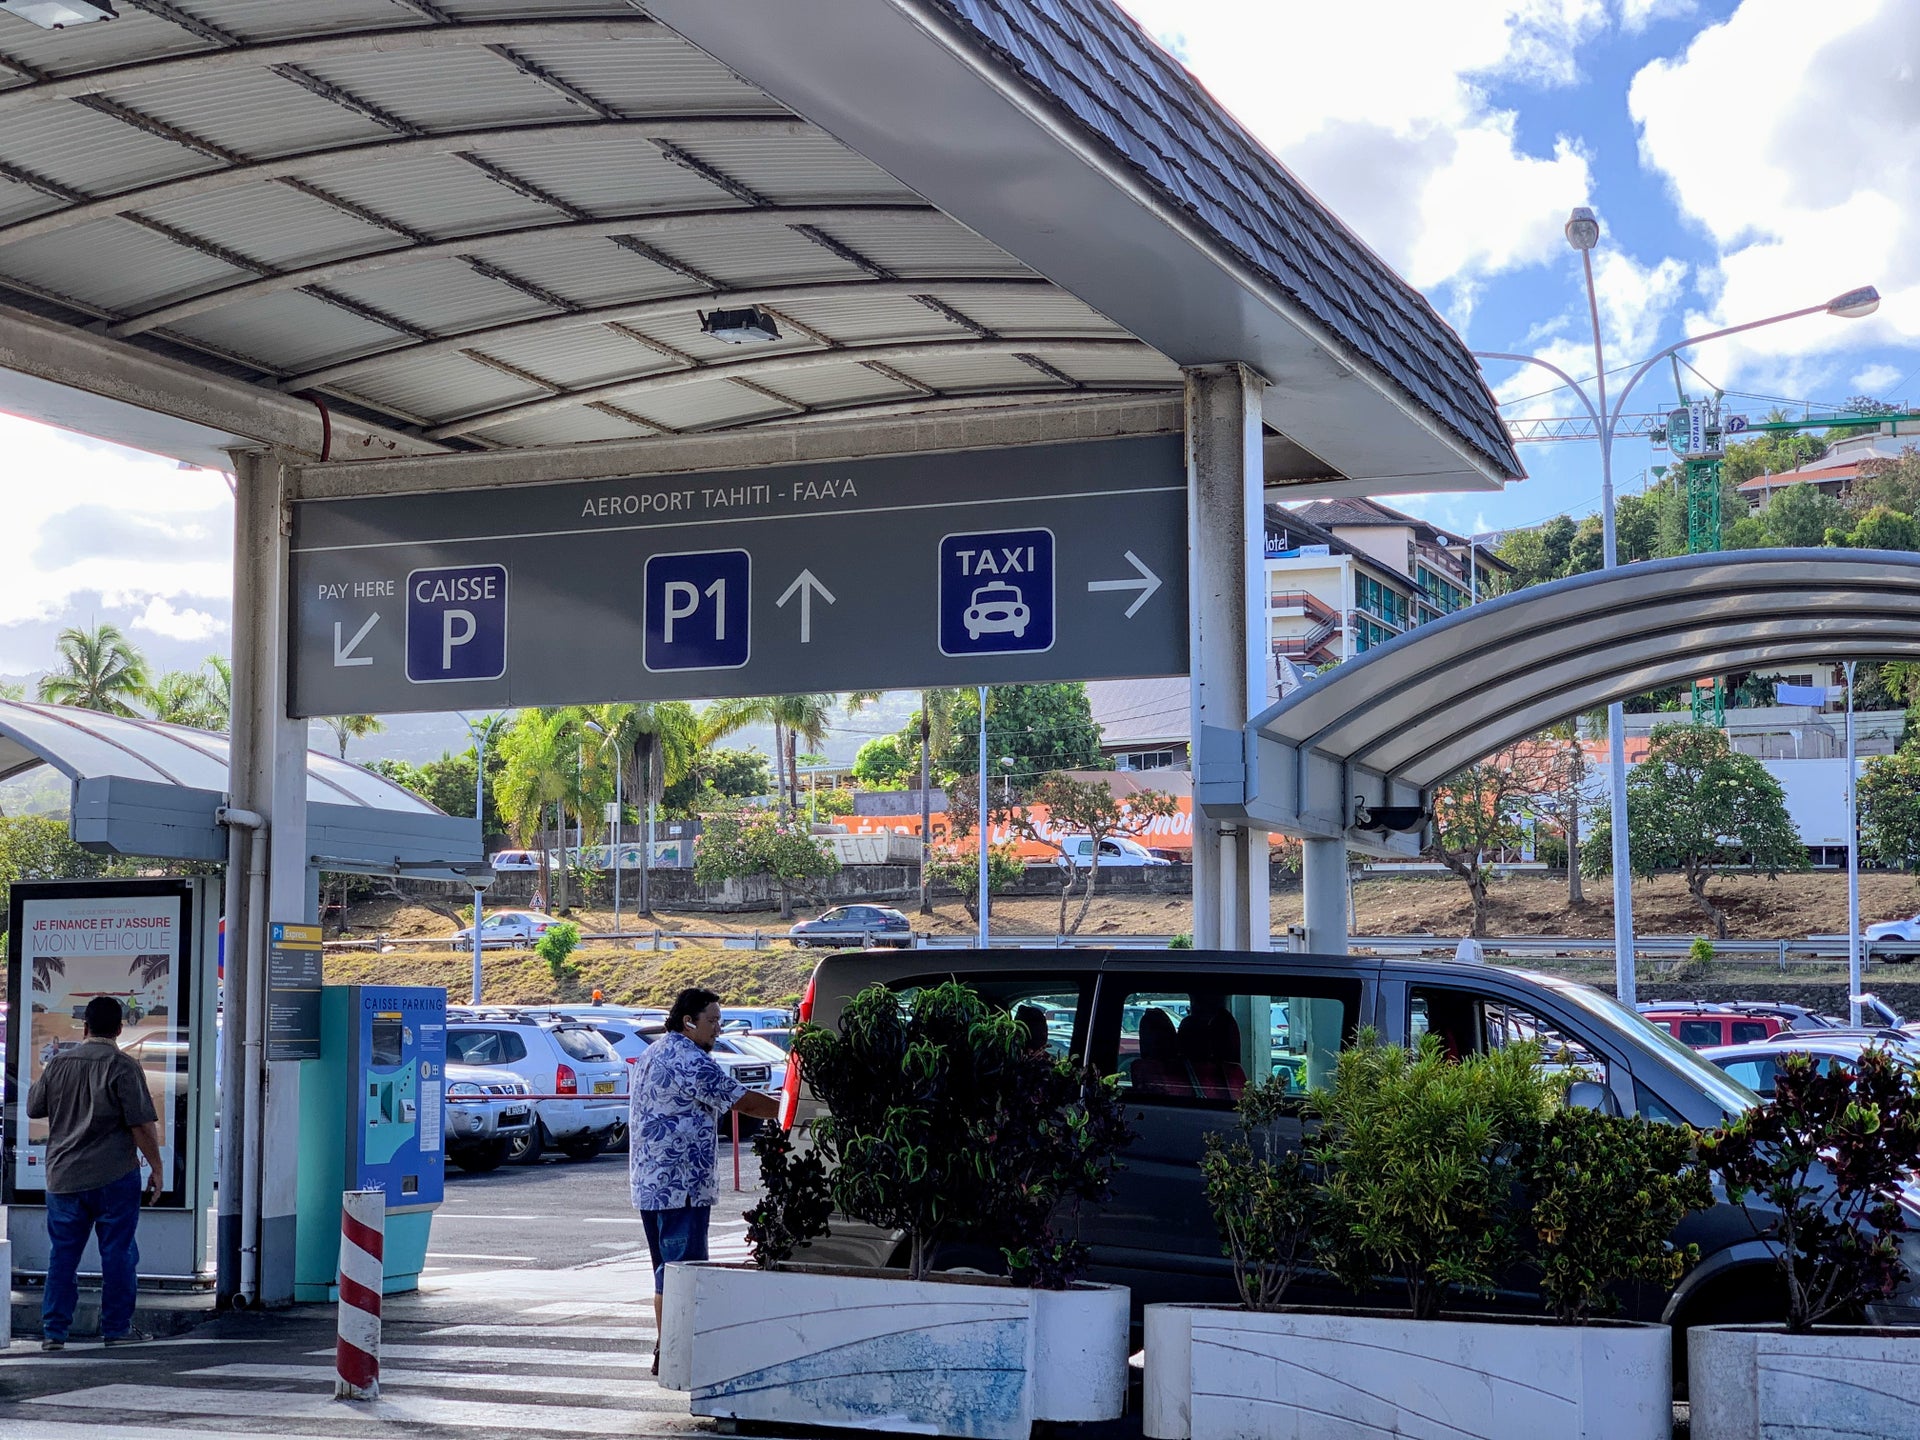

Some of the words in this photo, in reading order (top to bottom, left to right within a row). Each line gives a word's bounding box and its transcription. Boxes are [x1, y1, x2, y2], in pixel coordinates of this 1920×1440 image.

[1692, 416, 1700, 449] POTAIN
[581, 490, 695, 517] AEROPORT
[701, 485, 770, 508] TAHITI
[955, 546, 1035, 577] TAXI
[317, 582, 350, 601] PAY
[353, 580, 395, 599] HERE
[415, 576, 497, 604] CAISSE
[663, 578, 726, 644] P1
[442, 609, 477, 670] P
[33, 920, 47, 931] JE
[49, 919, 98, 930] FINANCE
[101, 918, 114, 929] ET
[116, 917, 171, 928] J'ASSURE
[273, 927, 282, 939] P1
[33, 934, 76, 952] MON
[82, 929, 171, 951] VÉHICULE
[364, 998, 398, 1010] CAISSE
[402, 998, 443, 1010] PARKING
